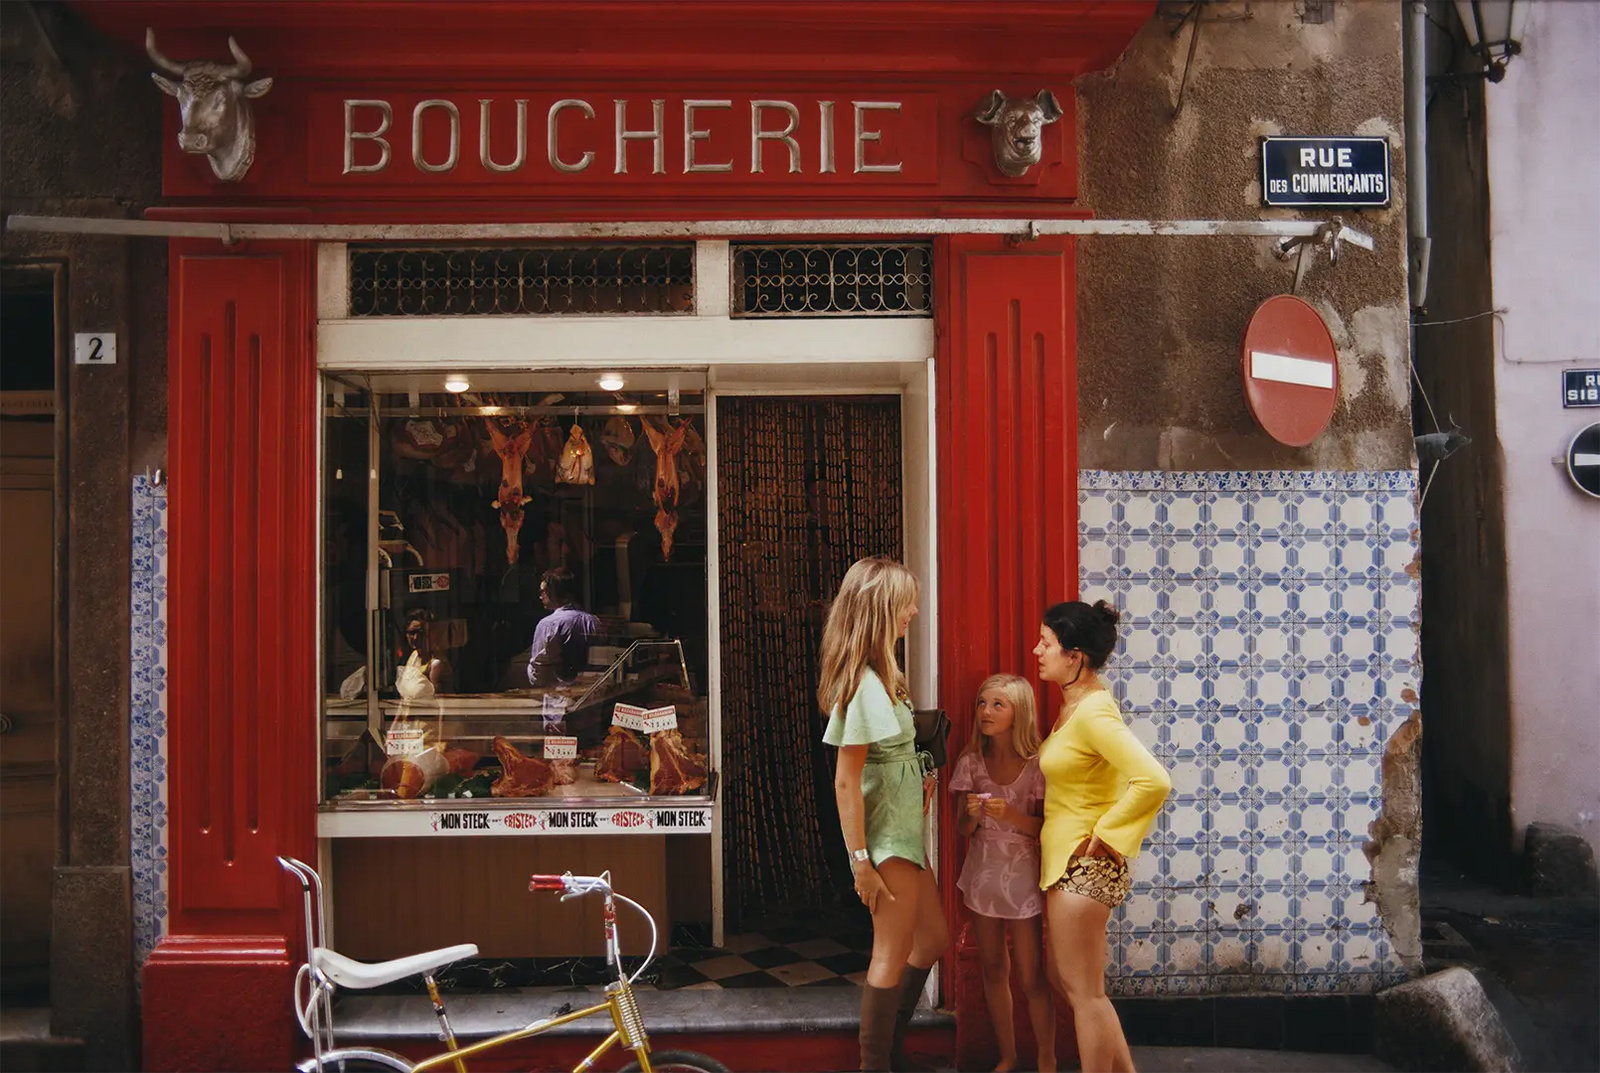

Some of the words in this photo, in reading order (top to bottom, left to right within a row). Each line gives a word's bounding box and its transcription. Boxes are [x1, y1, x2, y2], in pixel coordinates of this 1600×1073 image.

[342, 99, 903, 174] BOUCHERIE
[1300, 148, 1353, 168] RUE
[1270, 179, 1289, 193] DES
[1292, 173, 1384, 195] COMMERÇANTS
[88, 337, 104, 360] 2
[1585, 375, 1600, 387] R
[441, 813, 461, 829] MON
[463, 813, 490, 829] STECK
[549, 811, 568, 828] MON
[571, 811, 598, 828] STECK
[656, 810, 676, 826] MON
[679, 810, 706, 826] STECK
